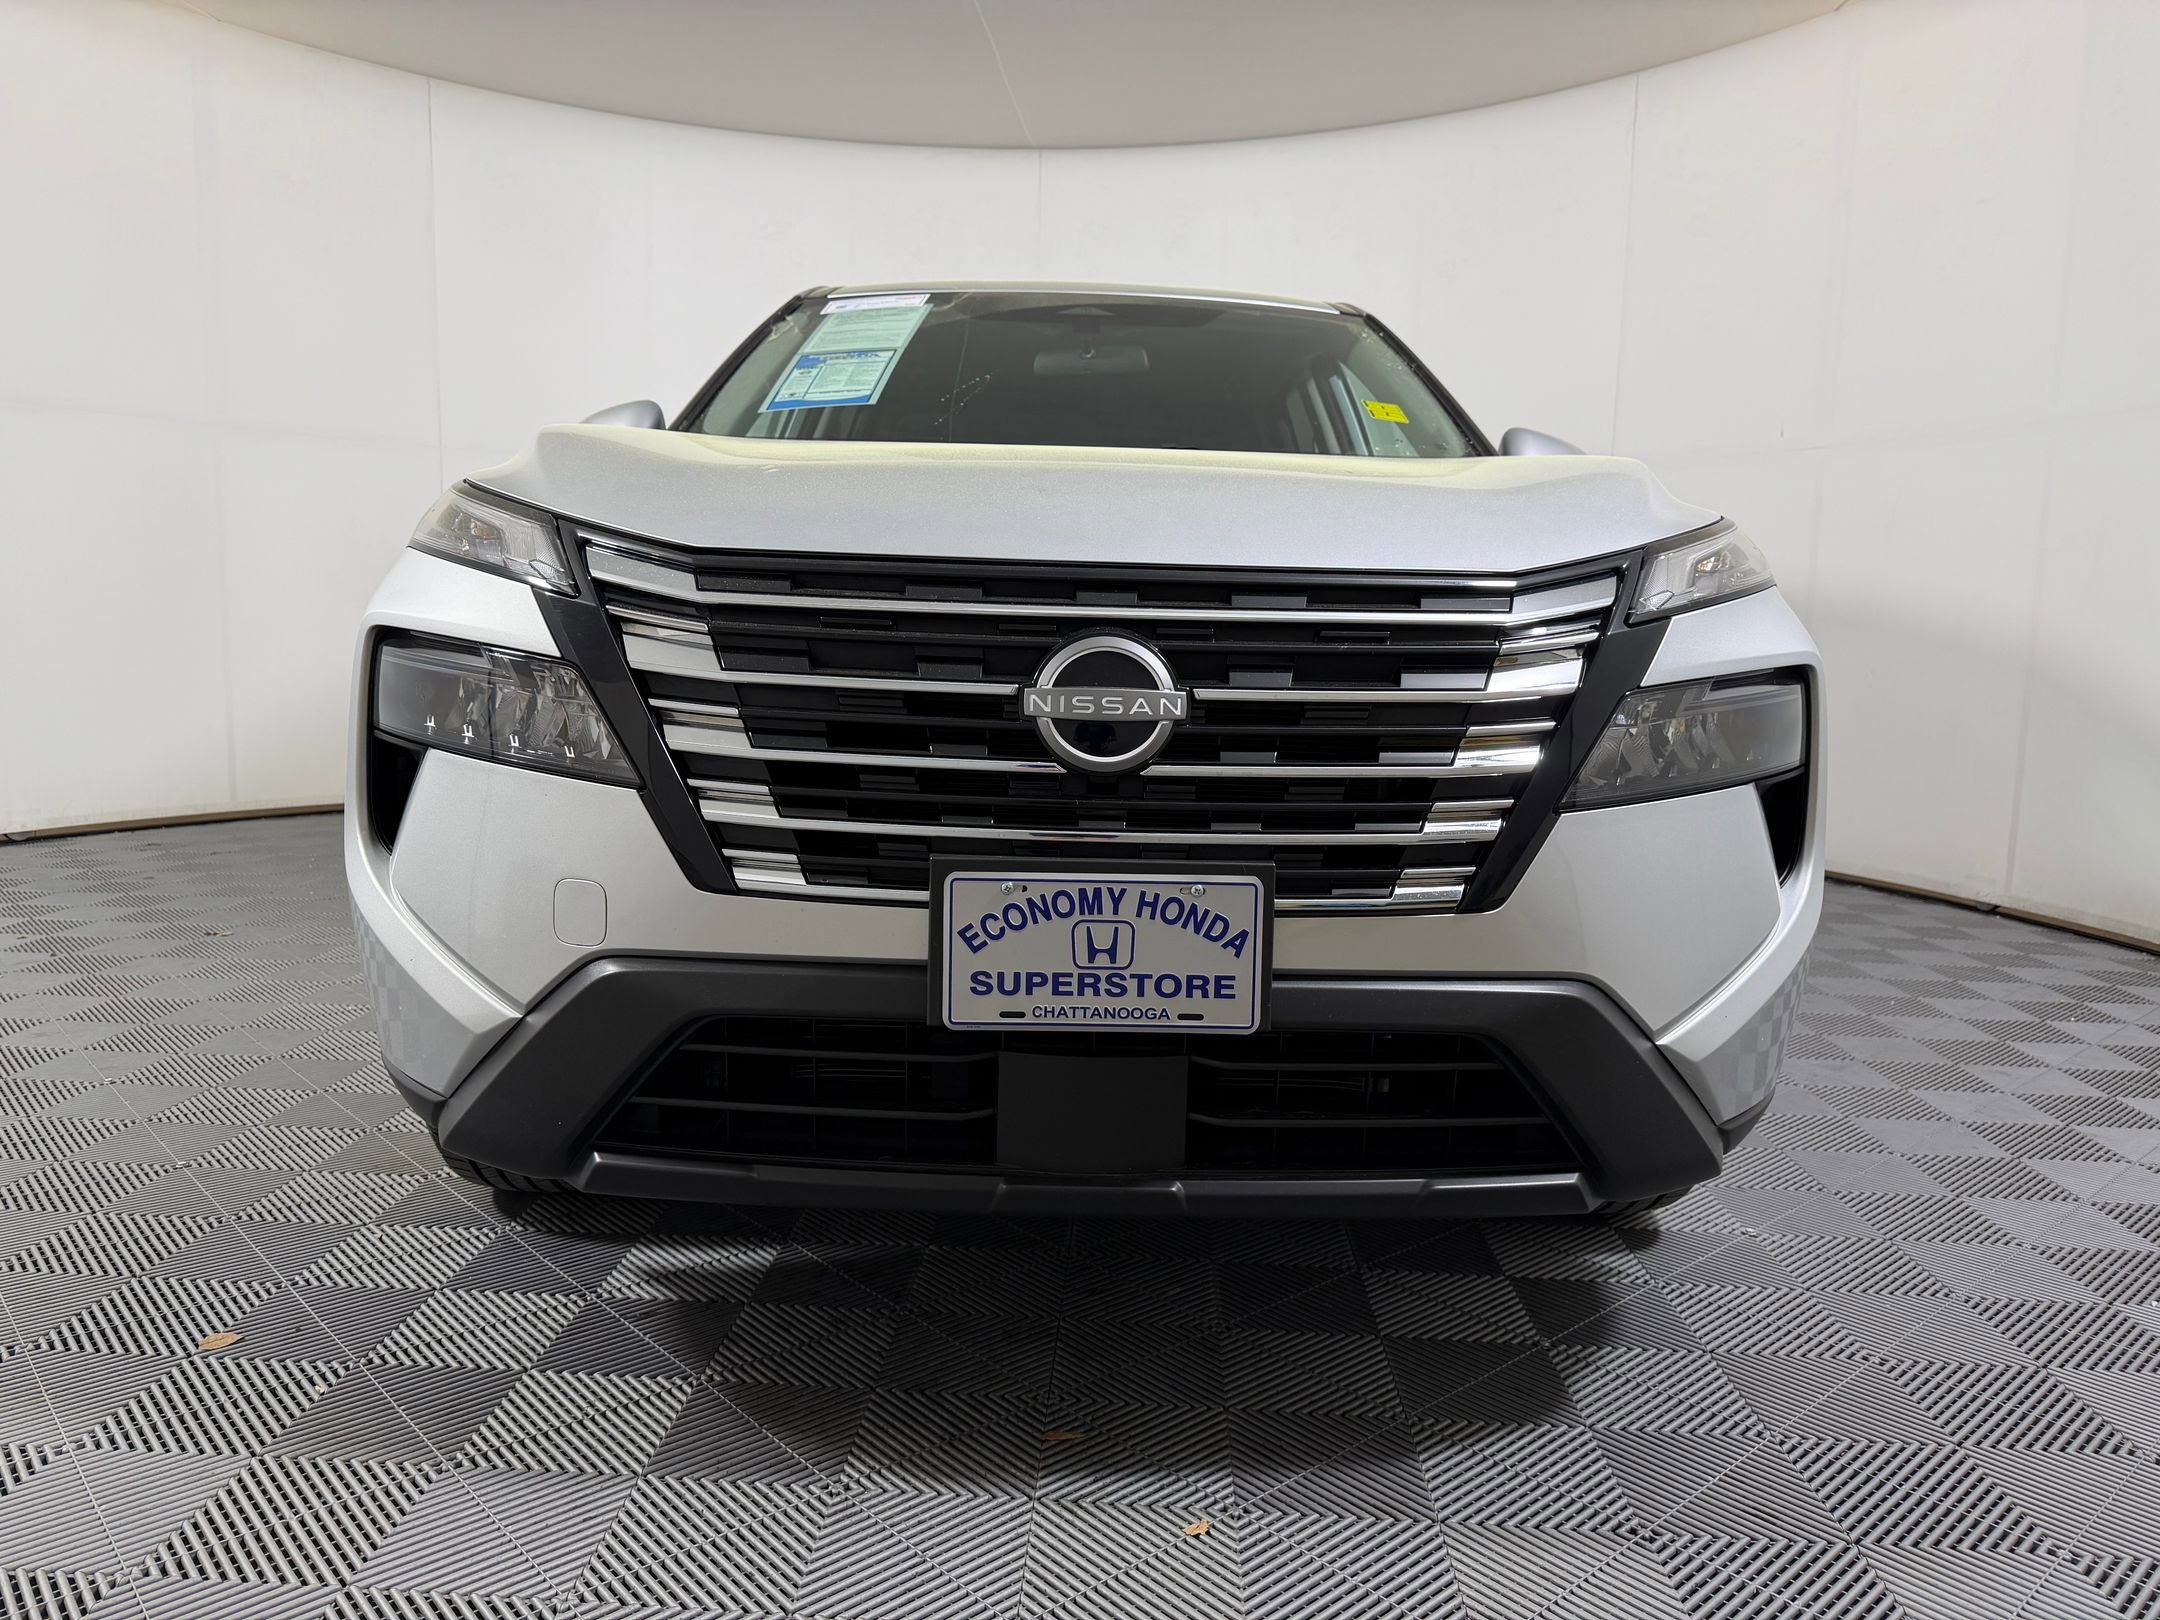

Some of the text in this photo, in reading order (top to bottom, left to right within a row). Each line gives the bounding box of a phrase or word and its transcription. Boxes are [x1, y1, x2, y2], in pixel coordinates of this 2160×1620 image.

[1029, 694, 1182, 716] NISSAN
[957, 886, 1250, 959] ECONOMY HONDA
[969, 970, 1236, 1000] SUPERSTORE
[1031, 1005, 1171, 1021] CHATTANOOGA
